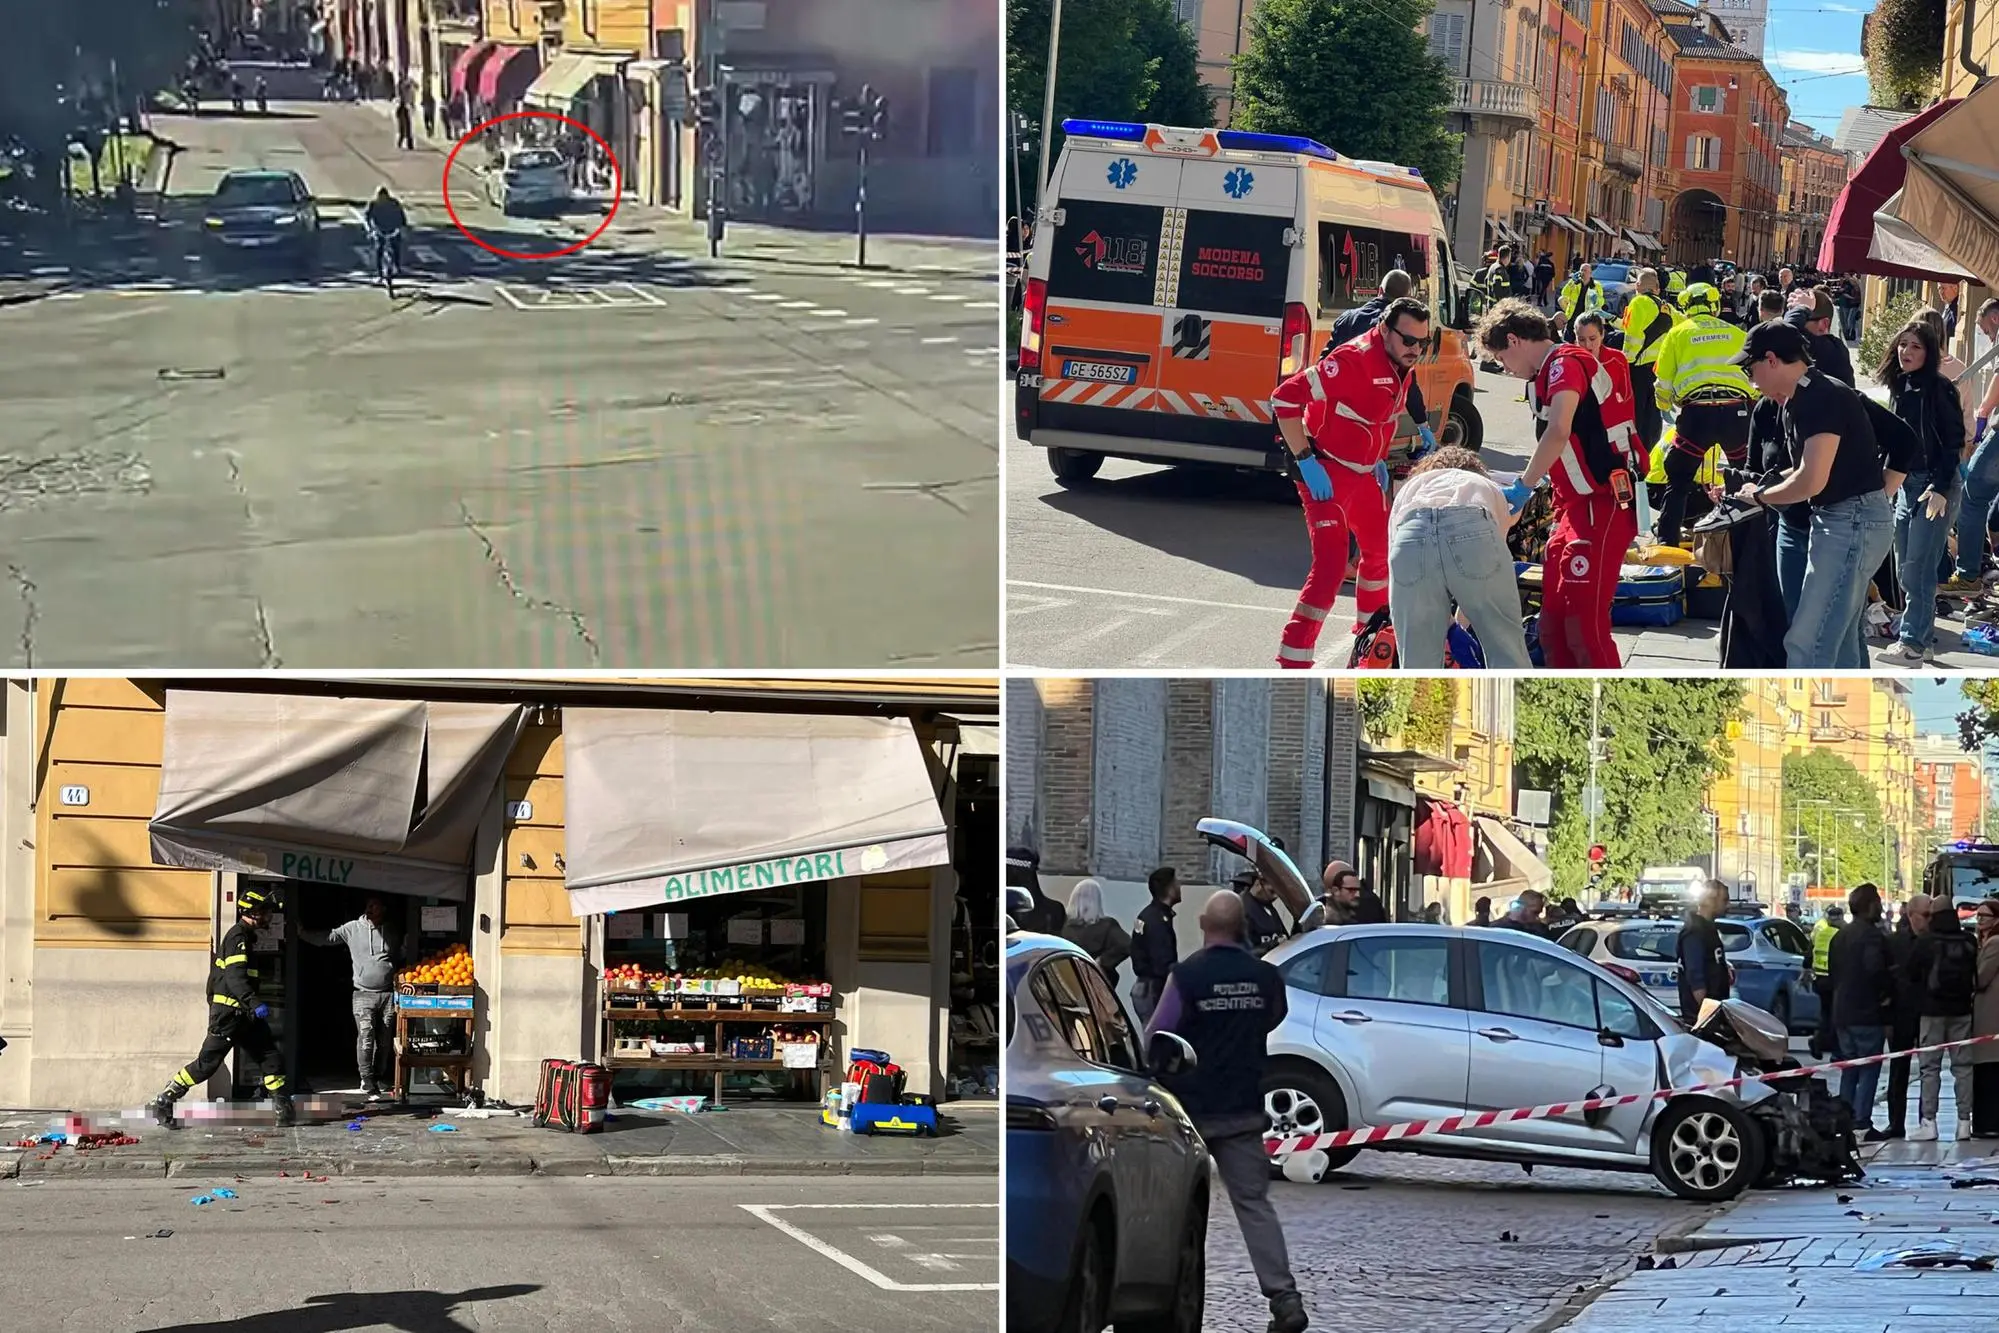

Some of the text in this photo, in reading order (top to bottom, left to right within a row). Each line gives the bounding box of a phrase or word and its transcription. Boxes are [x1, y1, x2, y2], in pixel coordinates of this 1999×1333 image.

[1198, 247, 1261, 265] MODENA
[1192, 262, 1264, 281] SOCCORSO
[1070, 362, 1129, 381] GE 565SZ
[282, 853, 354, 883] PALLY
[665, 851, 845, 900] ALIMENTARI
